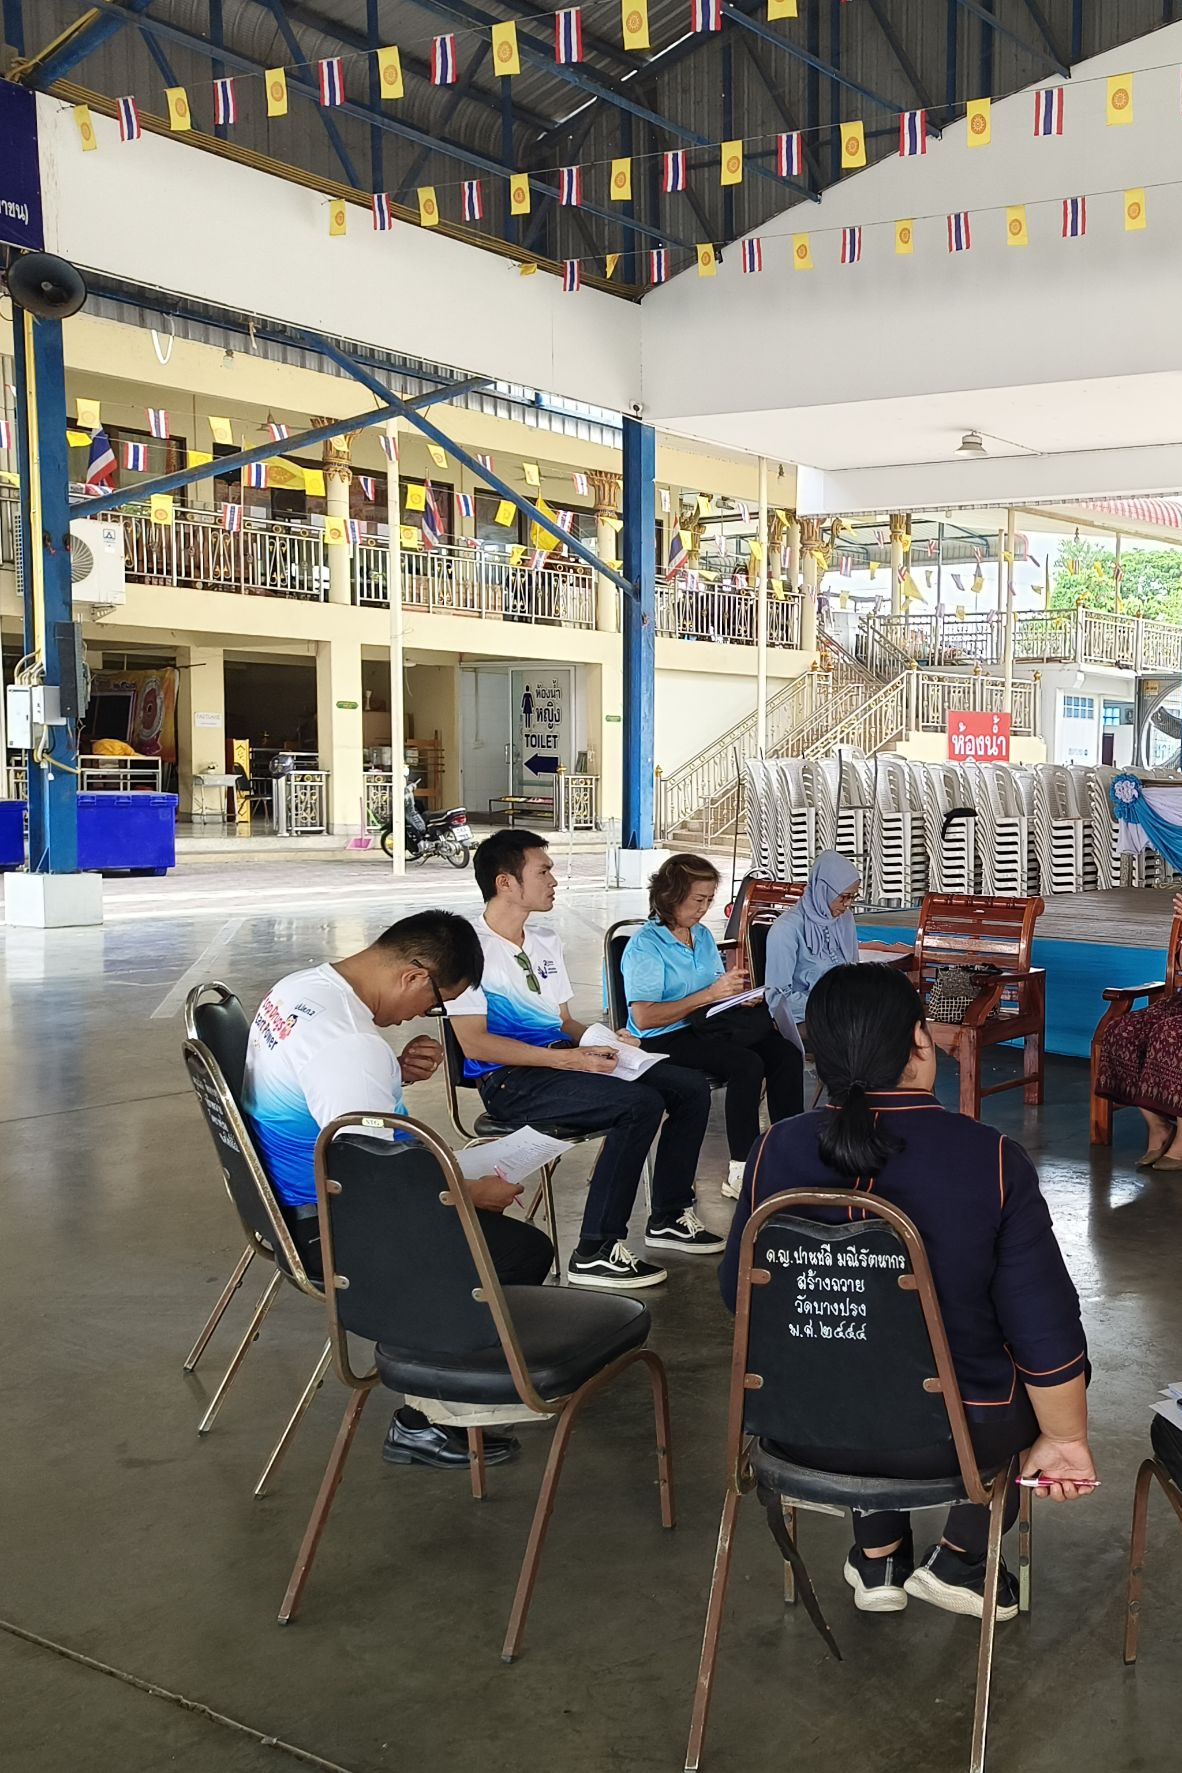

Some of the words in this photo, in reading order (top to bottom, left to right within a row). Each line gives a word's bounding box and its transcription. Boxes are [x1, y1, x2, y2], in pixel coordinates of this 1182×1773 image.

[0, 199, 29, 226] าชน)
[535, 680, 561, 699] ห้องน้ำ
[535, 701, 561, 729] หญิง
[524, 733, 558, 749] TOILET
[951, 714, 1007, 756] ห้องน้ำ
[796, 1269, 865, 1293] สร้างถวาย
[794, 1294, 867, 1317] วัดบางปรง
